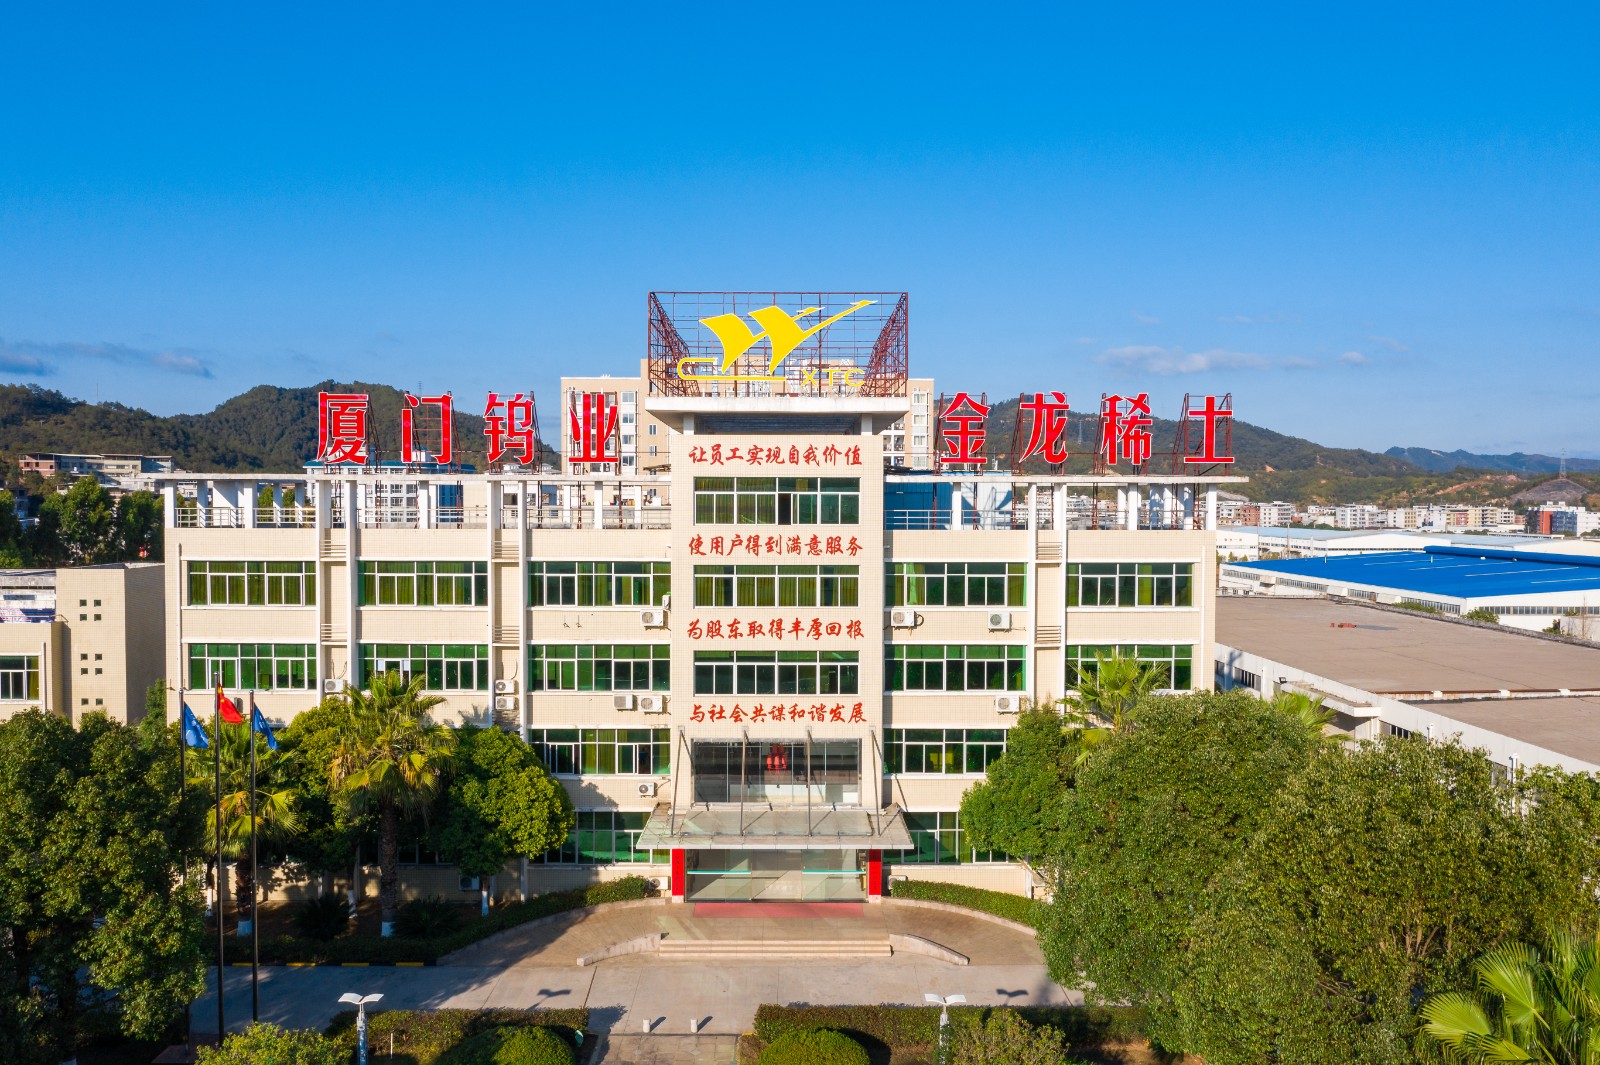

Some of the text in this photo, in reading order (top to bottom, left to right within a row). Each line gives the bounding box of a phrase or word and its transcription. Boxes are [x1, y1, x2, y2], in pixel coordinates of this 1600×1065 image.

[802, 368, 865, 387] XTC
[316, 391, 619, 465] 厦门钨业
[940, 391, 1235, 466] 金龙稀土
[688, 444, 863, 466] 让员工实现自我价值
[688, 534, 863, 557] 使用户得到满意服务
[686, 617, 865, 640] 为股东取得丰厚回报
[689, 703, 868, 724] 与社会共谋和谐发展
